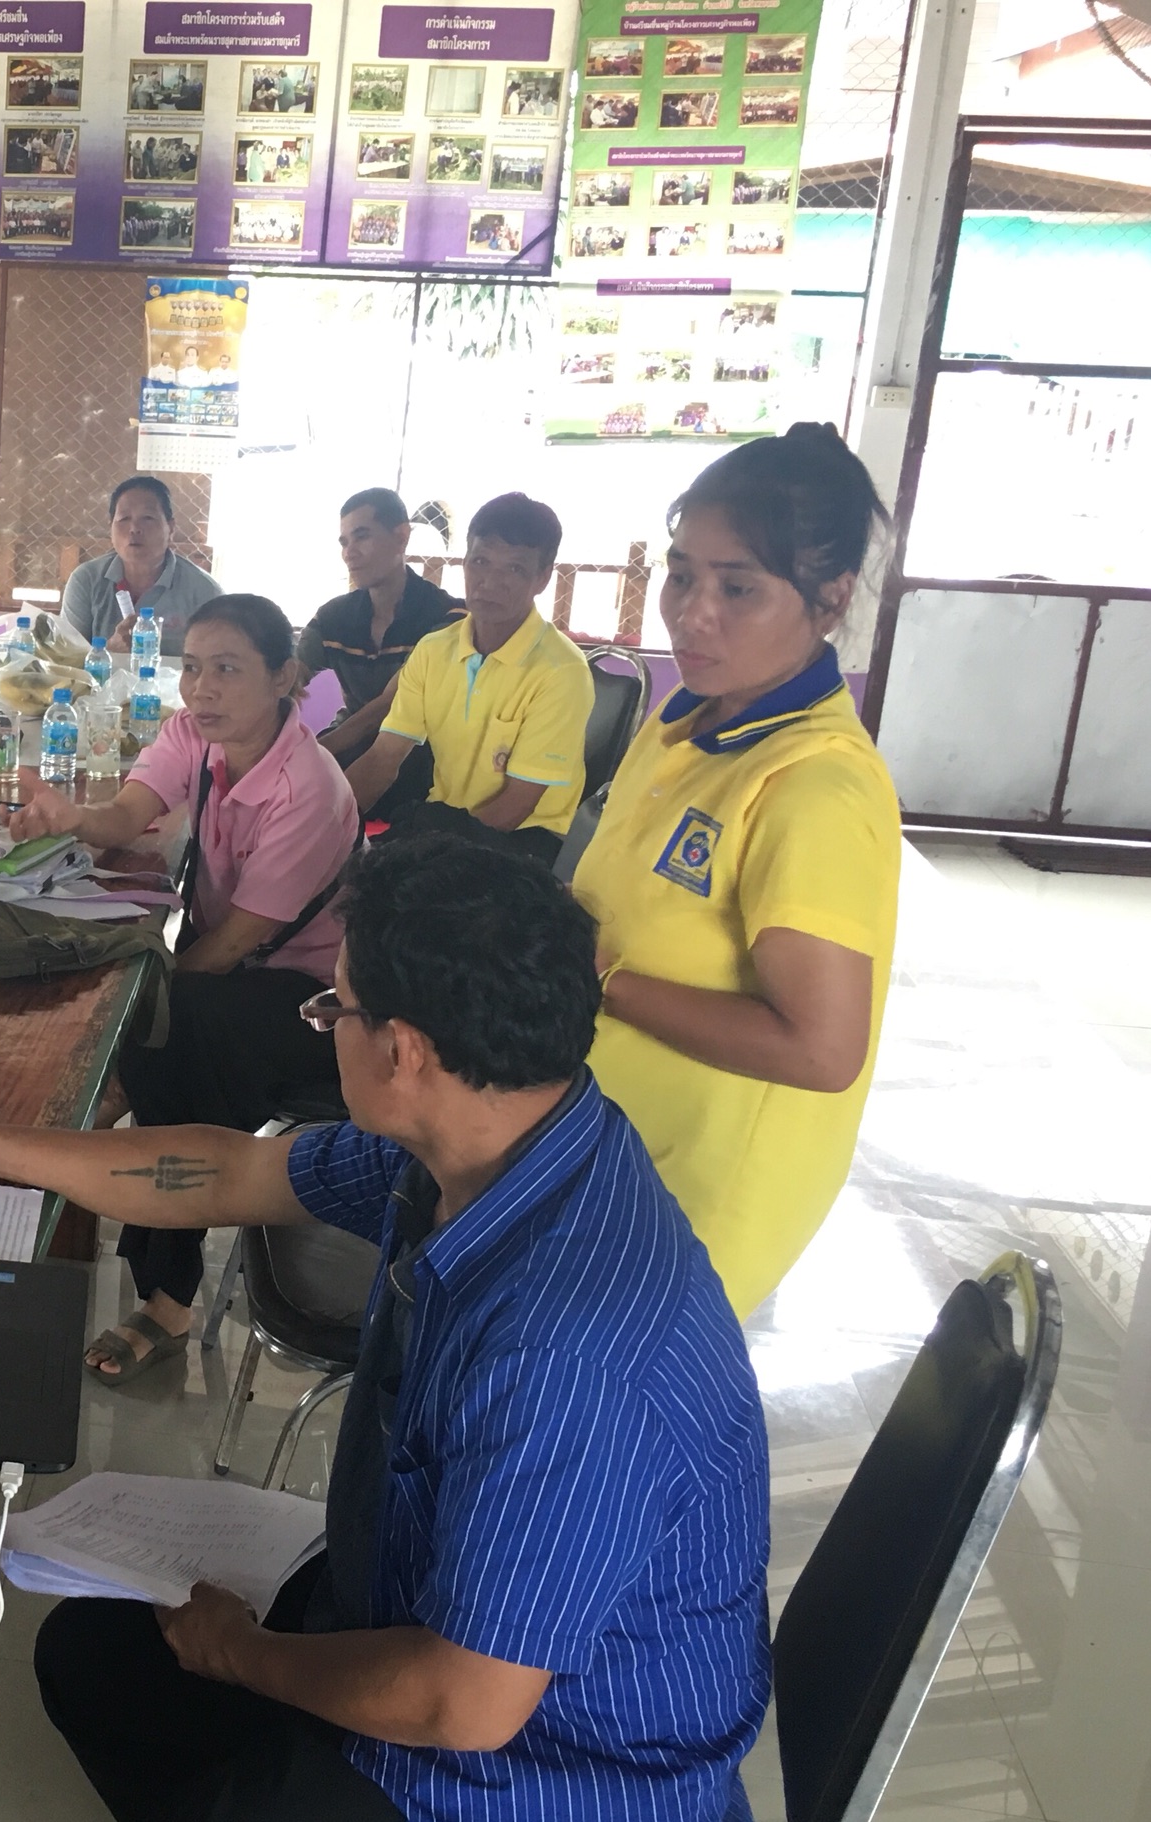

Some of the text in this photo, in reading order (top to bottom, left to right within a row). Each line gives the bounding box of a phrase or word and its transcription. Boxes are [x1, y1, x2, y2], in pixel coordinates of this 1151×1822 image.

[425, 14, 496, 30] การดำเนินกิจกรรม
[427, 35, 491, 51] สมาชิกโครงการฯ
